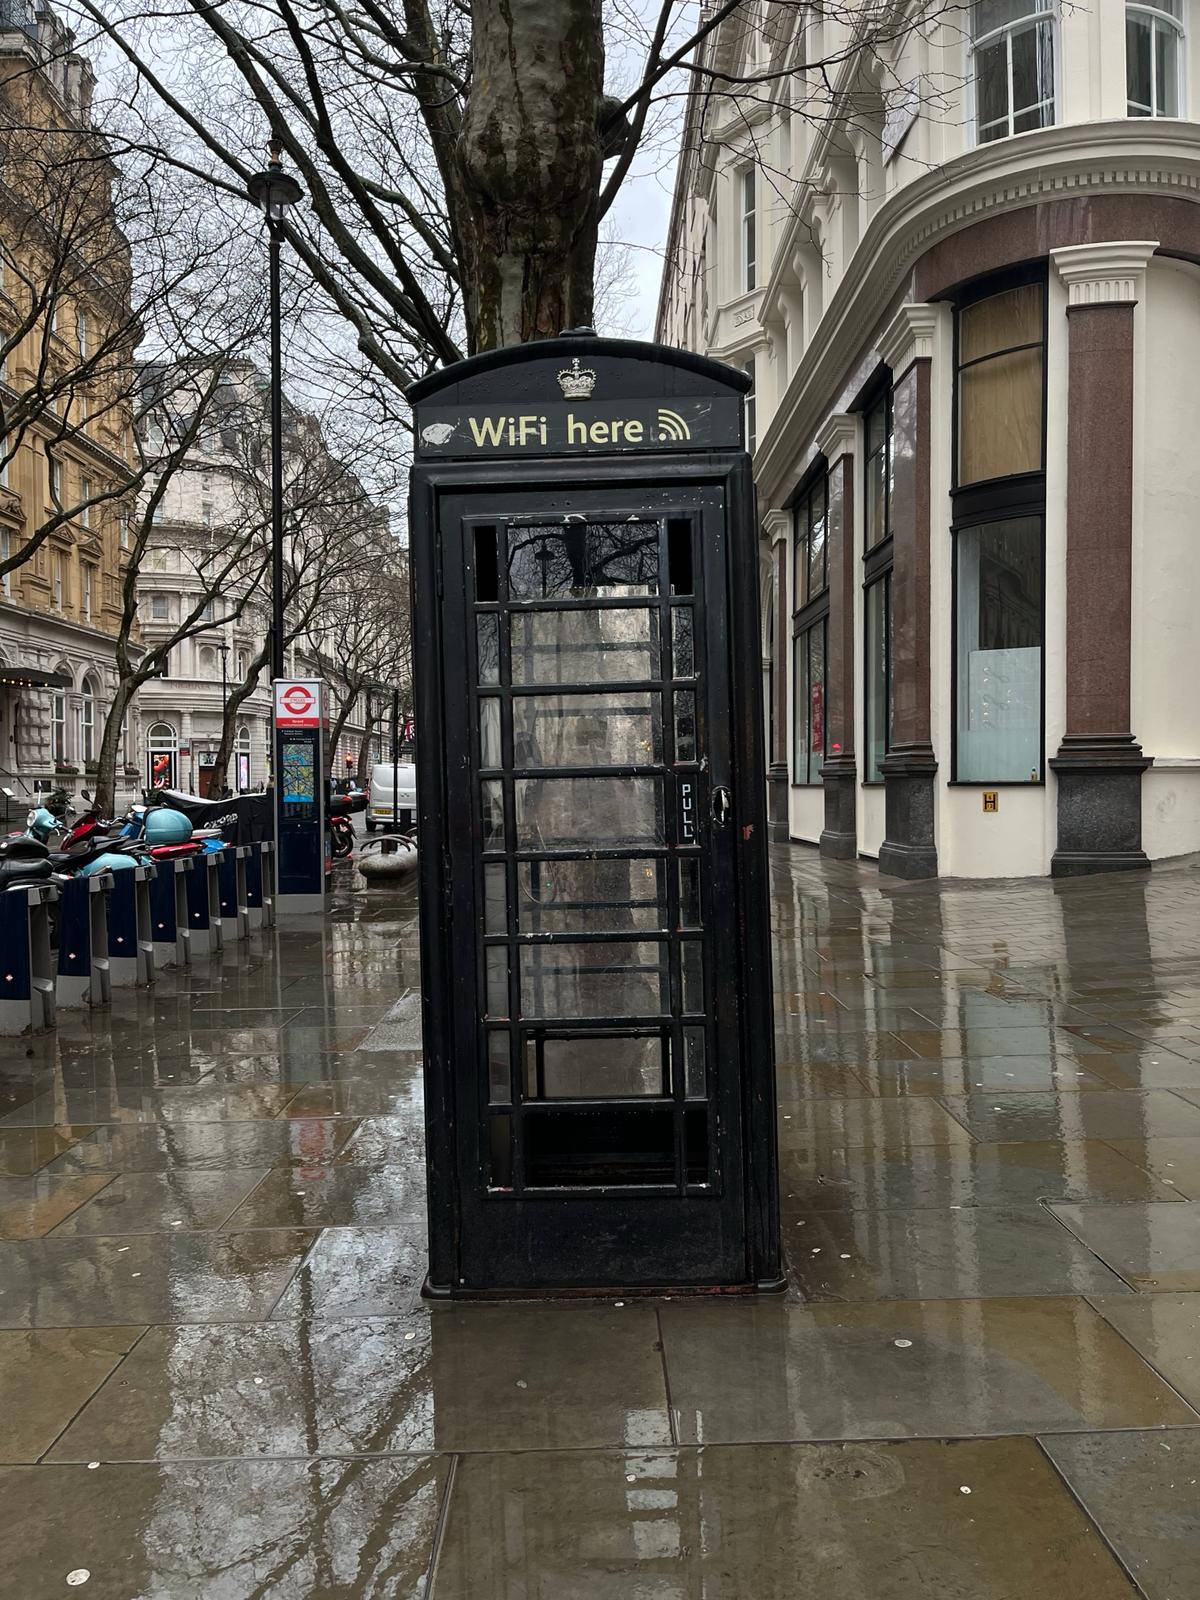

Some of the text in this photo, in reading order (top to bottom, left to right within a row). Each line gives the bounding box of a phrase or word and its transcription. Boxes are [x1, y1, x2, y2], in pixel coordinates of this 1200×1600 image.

[469, 413, 643, 447] WiFi here
[682, 784, 693, 837] PULL
[985, 794, 996, 810] H
[203, 813, 239, 829] OXFORD
